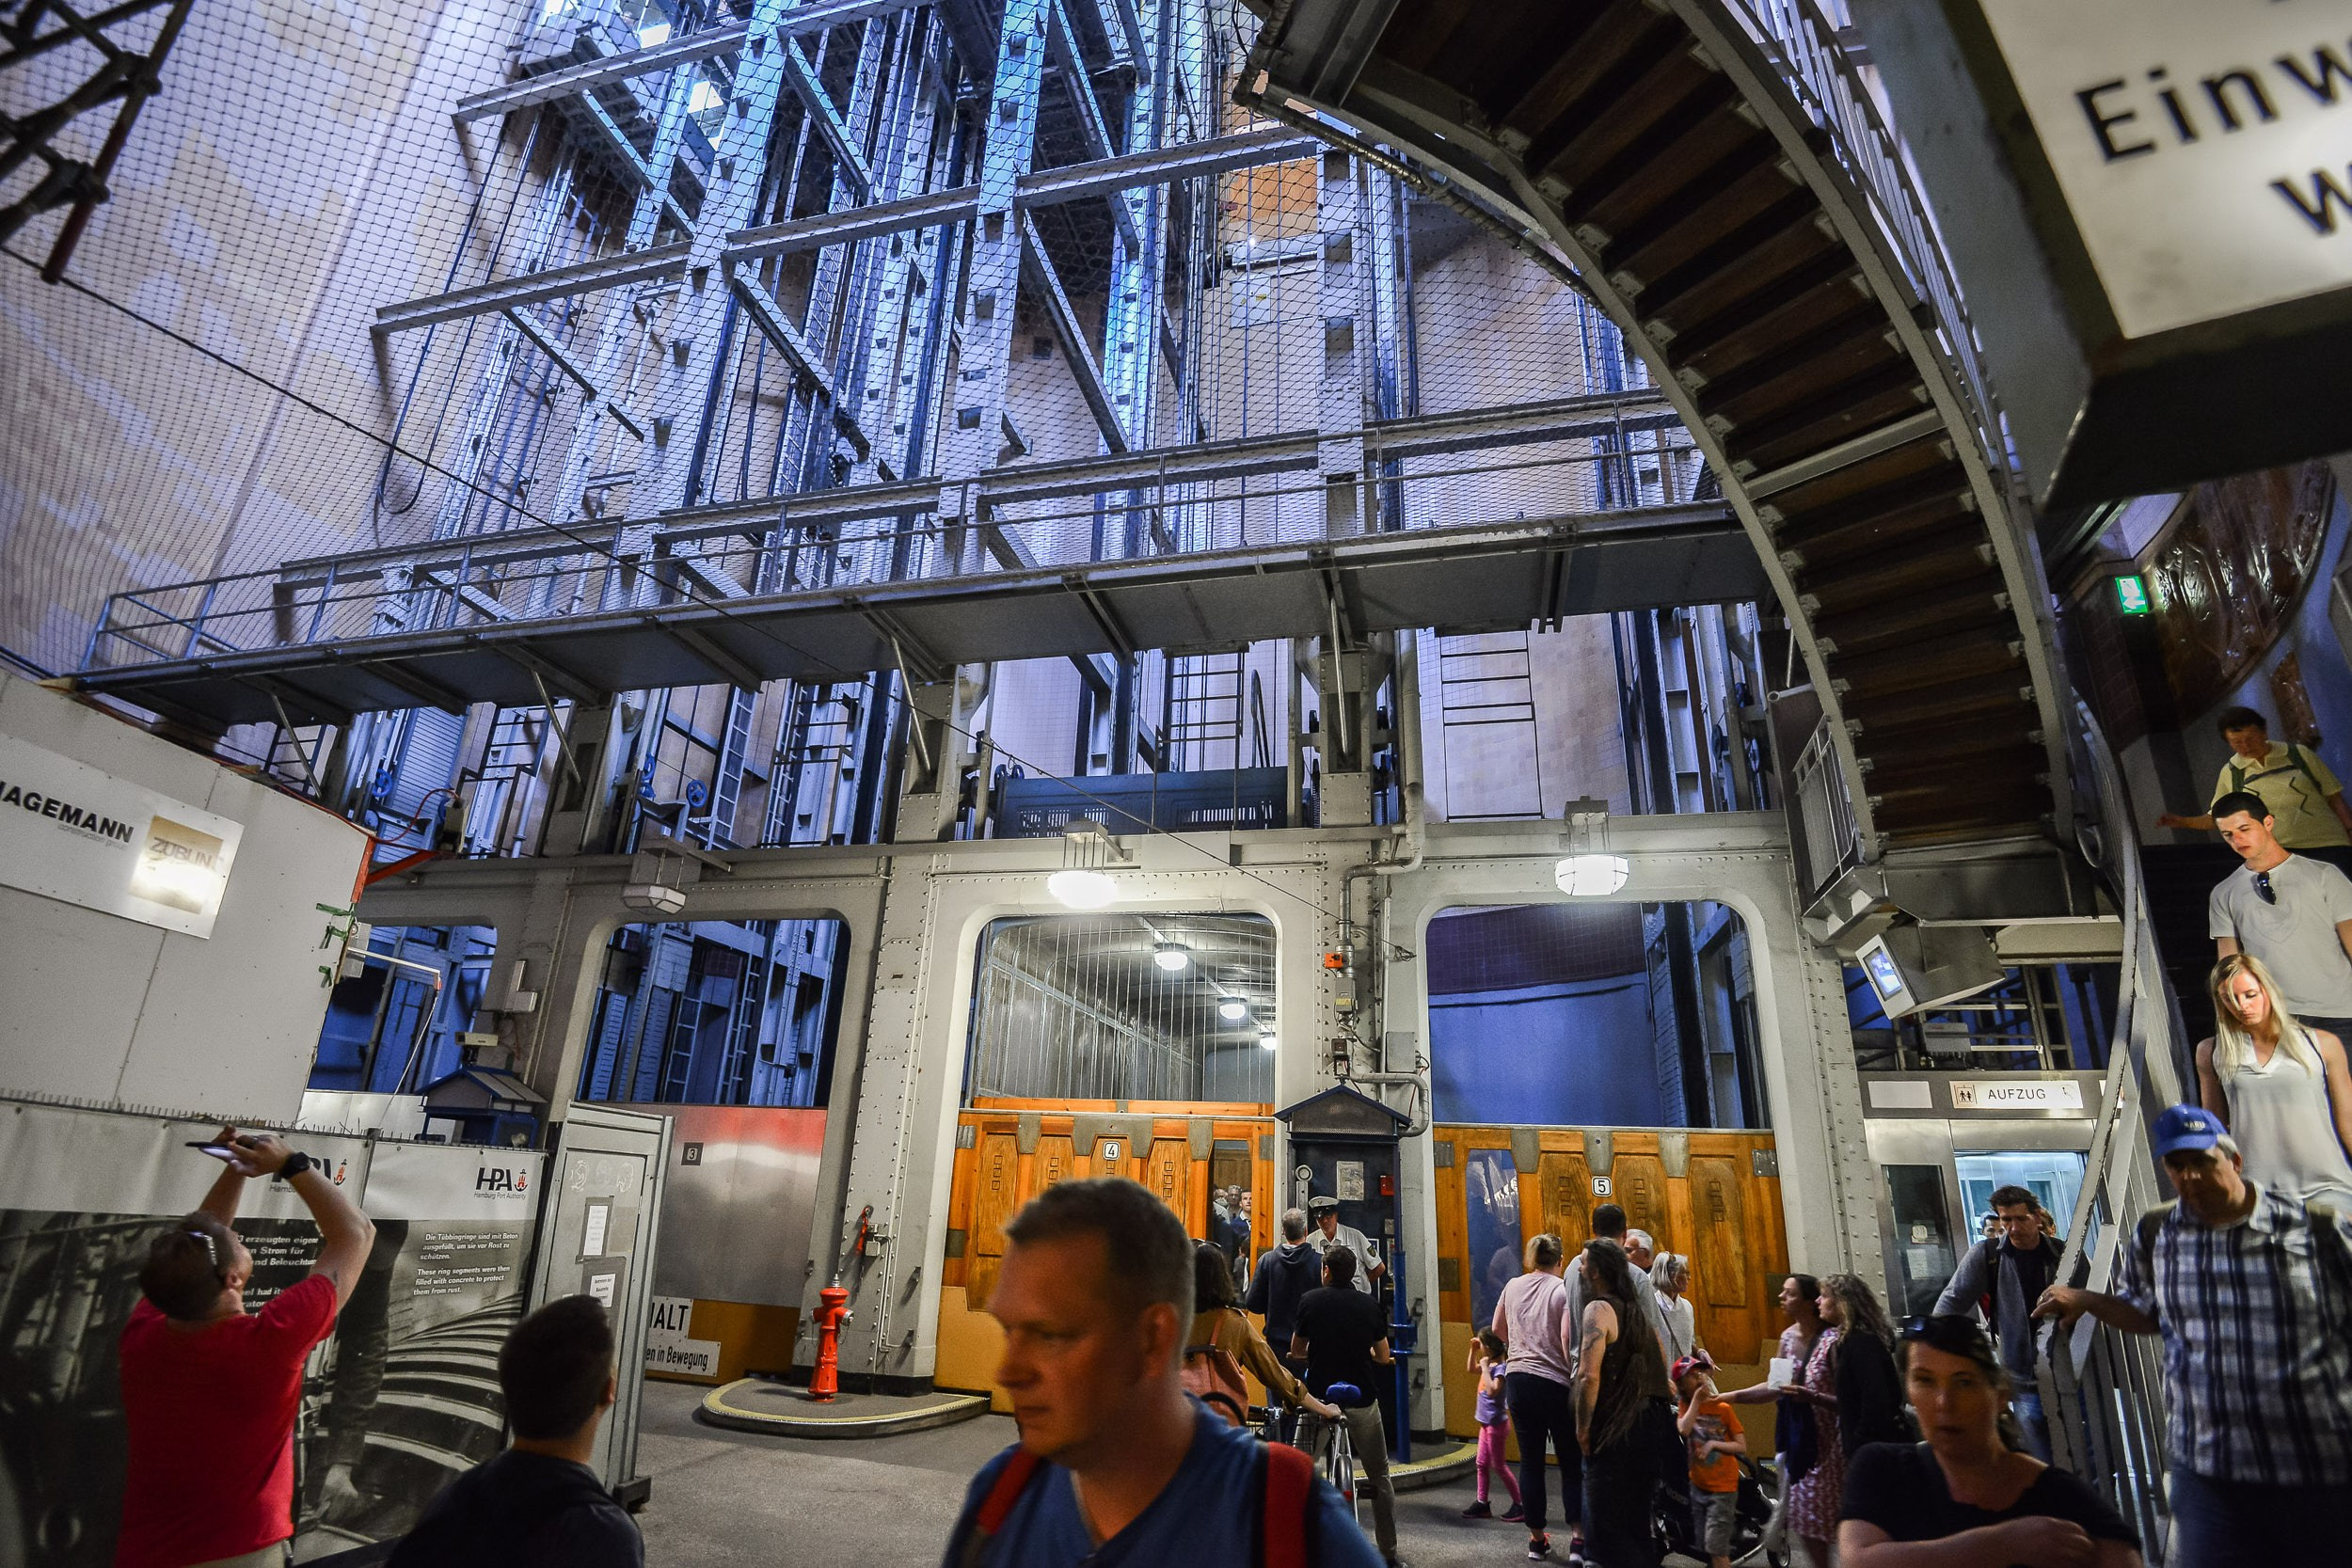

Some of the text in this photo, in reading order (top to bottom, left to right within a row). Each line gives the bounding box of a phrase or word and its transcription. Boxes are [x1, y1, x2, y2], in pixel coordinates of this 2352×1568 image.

[1988, 1088, 2046, 1100] AUFZUG
[689, 1148, 696, 1160] 3
[1107, 1144, 1115, 1157] 4
[475, 1167, 513, 1192] HPA
[1597, 1180, 1607, 1194] 5
[246, 1235, 291, 1245] erzeugten
[260, 1246, 288, 1255] Strom
[290, 1246, 305, 1255] für
[437, 1267, 452, 1276] ring
[453, 1266, 481, 1275] segments
[415, 1277, 433, 1286] filled
[433, 1276, 447, 1285] with
[483, 1275, 505, 1284] protect
[257, 1287, 272, 1295] had
[413, 1288, 430, 1296] them
[431, 1287, 447, 1295] from
[657, 1345, 665, 1363] in
[666, 1345, 709, 1372] Bewegung
